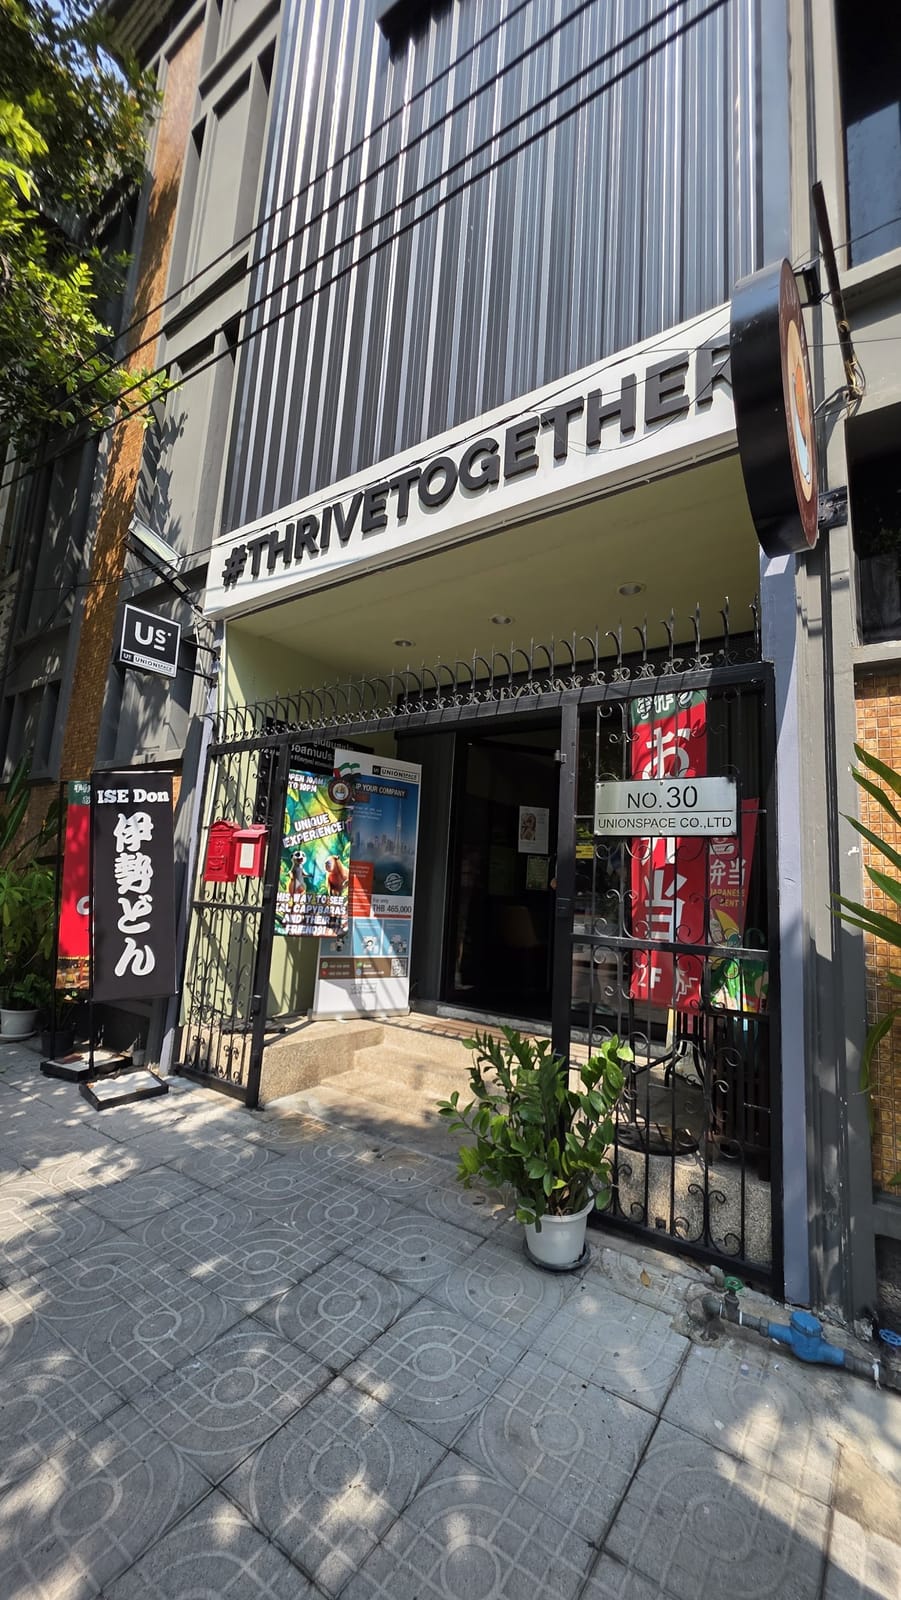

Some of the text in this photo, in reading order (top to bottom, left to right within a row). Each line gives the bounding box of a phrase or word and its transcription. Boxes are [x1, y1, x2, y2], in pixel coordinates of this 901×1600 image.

[97, 790, 129, 804] ISE
[133, 789, 170, 803] Don
[363, 784, 378, 793] YOUR
[379, 786, 406, 797] COMPANY
[627, 785, 698, 809] NO. 30
[294, 813, 330, 832] UNIQUE
[598, 817, 732, 829] UNIONSPACE CO.,LTD
[710, 858, 747, 886] 弁当
[113, 811, 156, 977] 伊勢どん
[276, 892, 345, 905] HIS WAY TO SEE
[293, 903, 347, 915] CAPYBARAS
[372, 904, 385, 912] THB
[281, 913, 331, 925] AND THEIR
